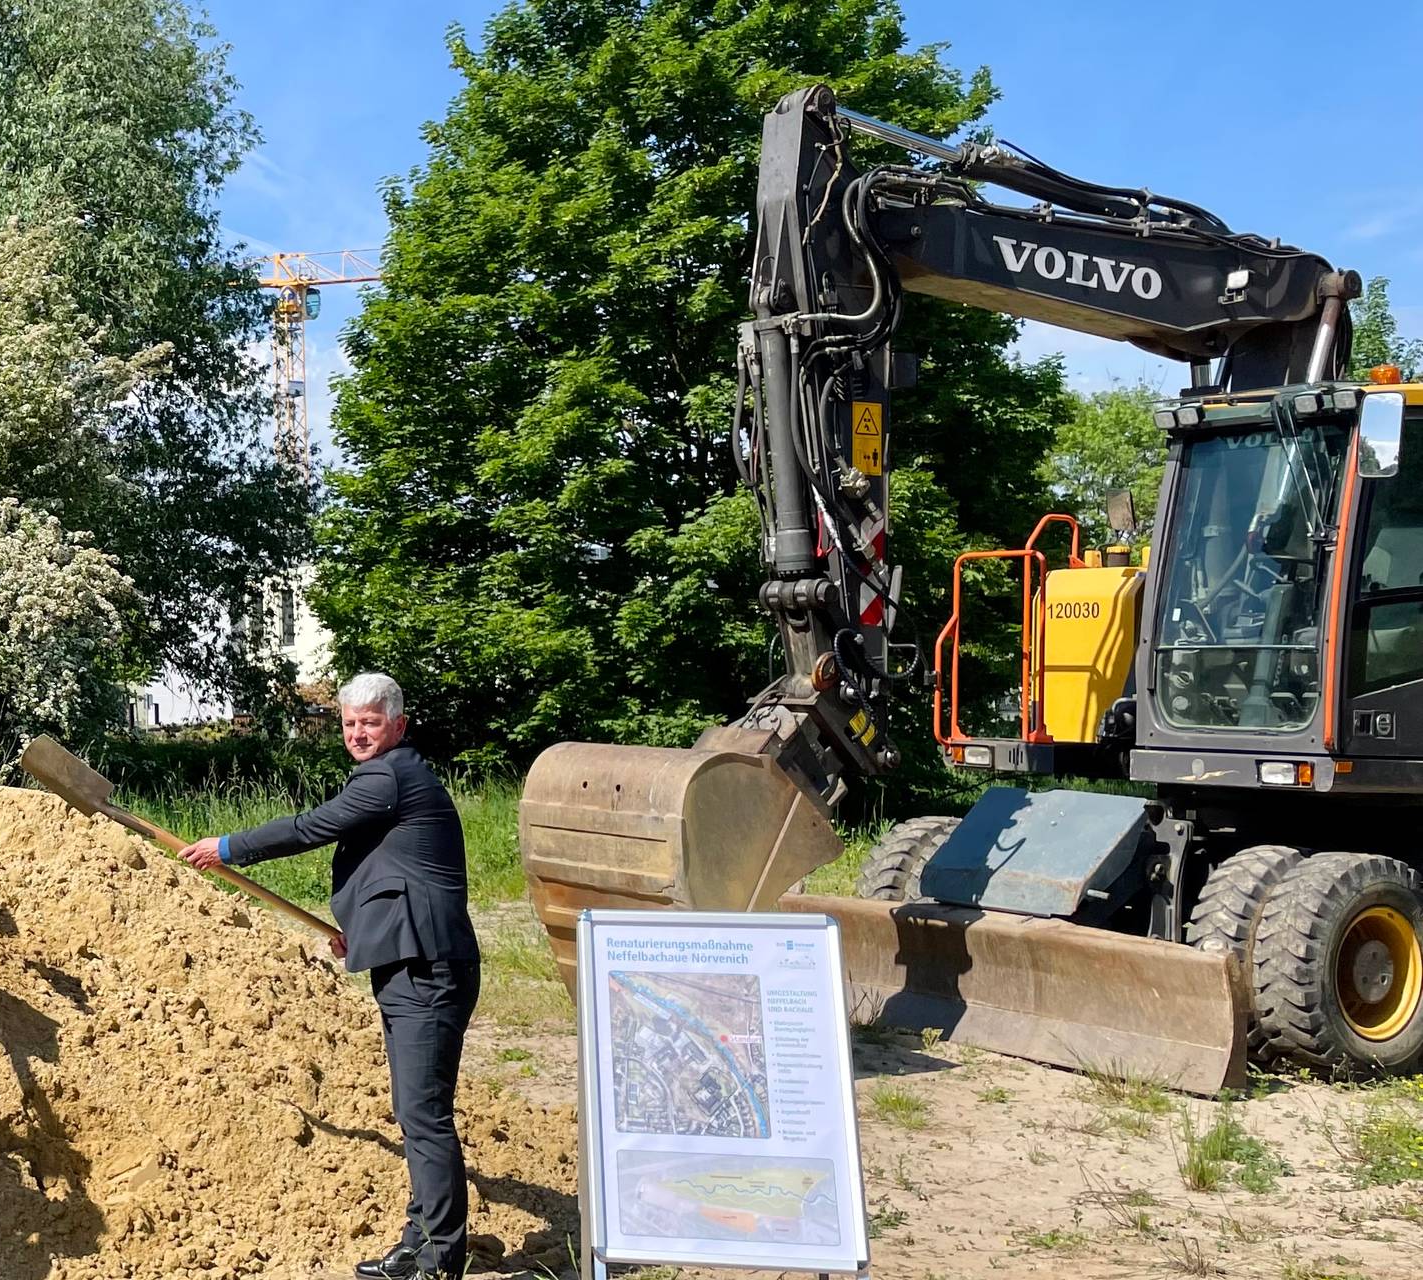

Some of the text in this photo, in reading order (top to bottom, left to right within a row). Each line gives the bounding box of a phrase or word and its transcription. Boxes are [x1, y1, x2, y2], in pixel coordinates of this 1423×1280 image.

[993, 235, 1163, 300] VOLVO
[1227, 427, 1315, 449] VOLO
[1047, 602, 1100, 619] 120030
[606, 937, 754, 951] Renaturierungsmaßnahme
[607, 950, 749, 965] Neffelbachaue Nörvenich
